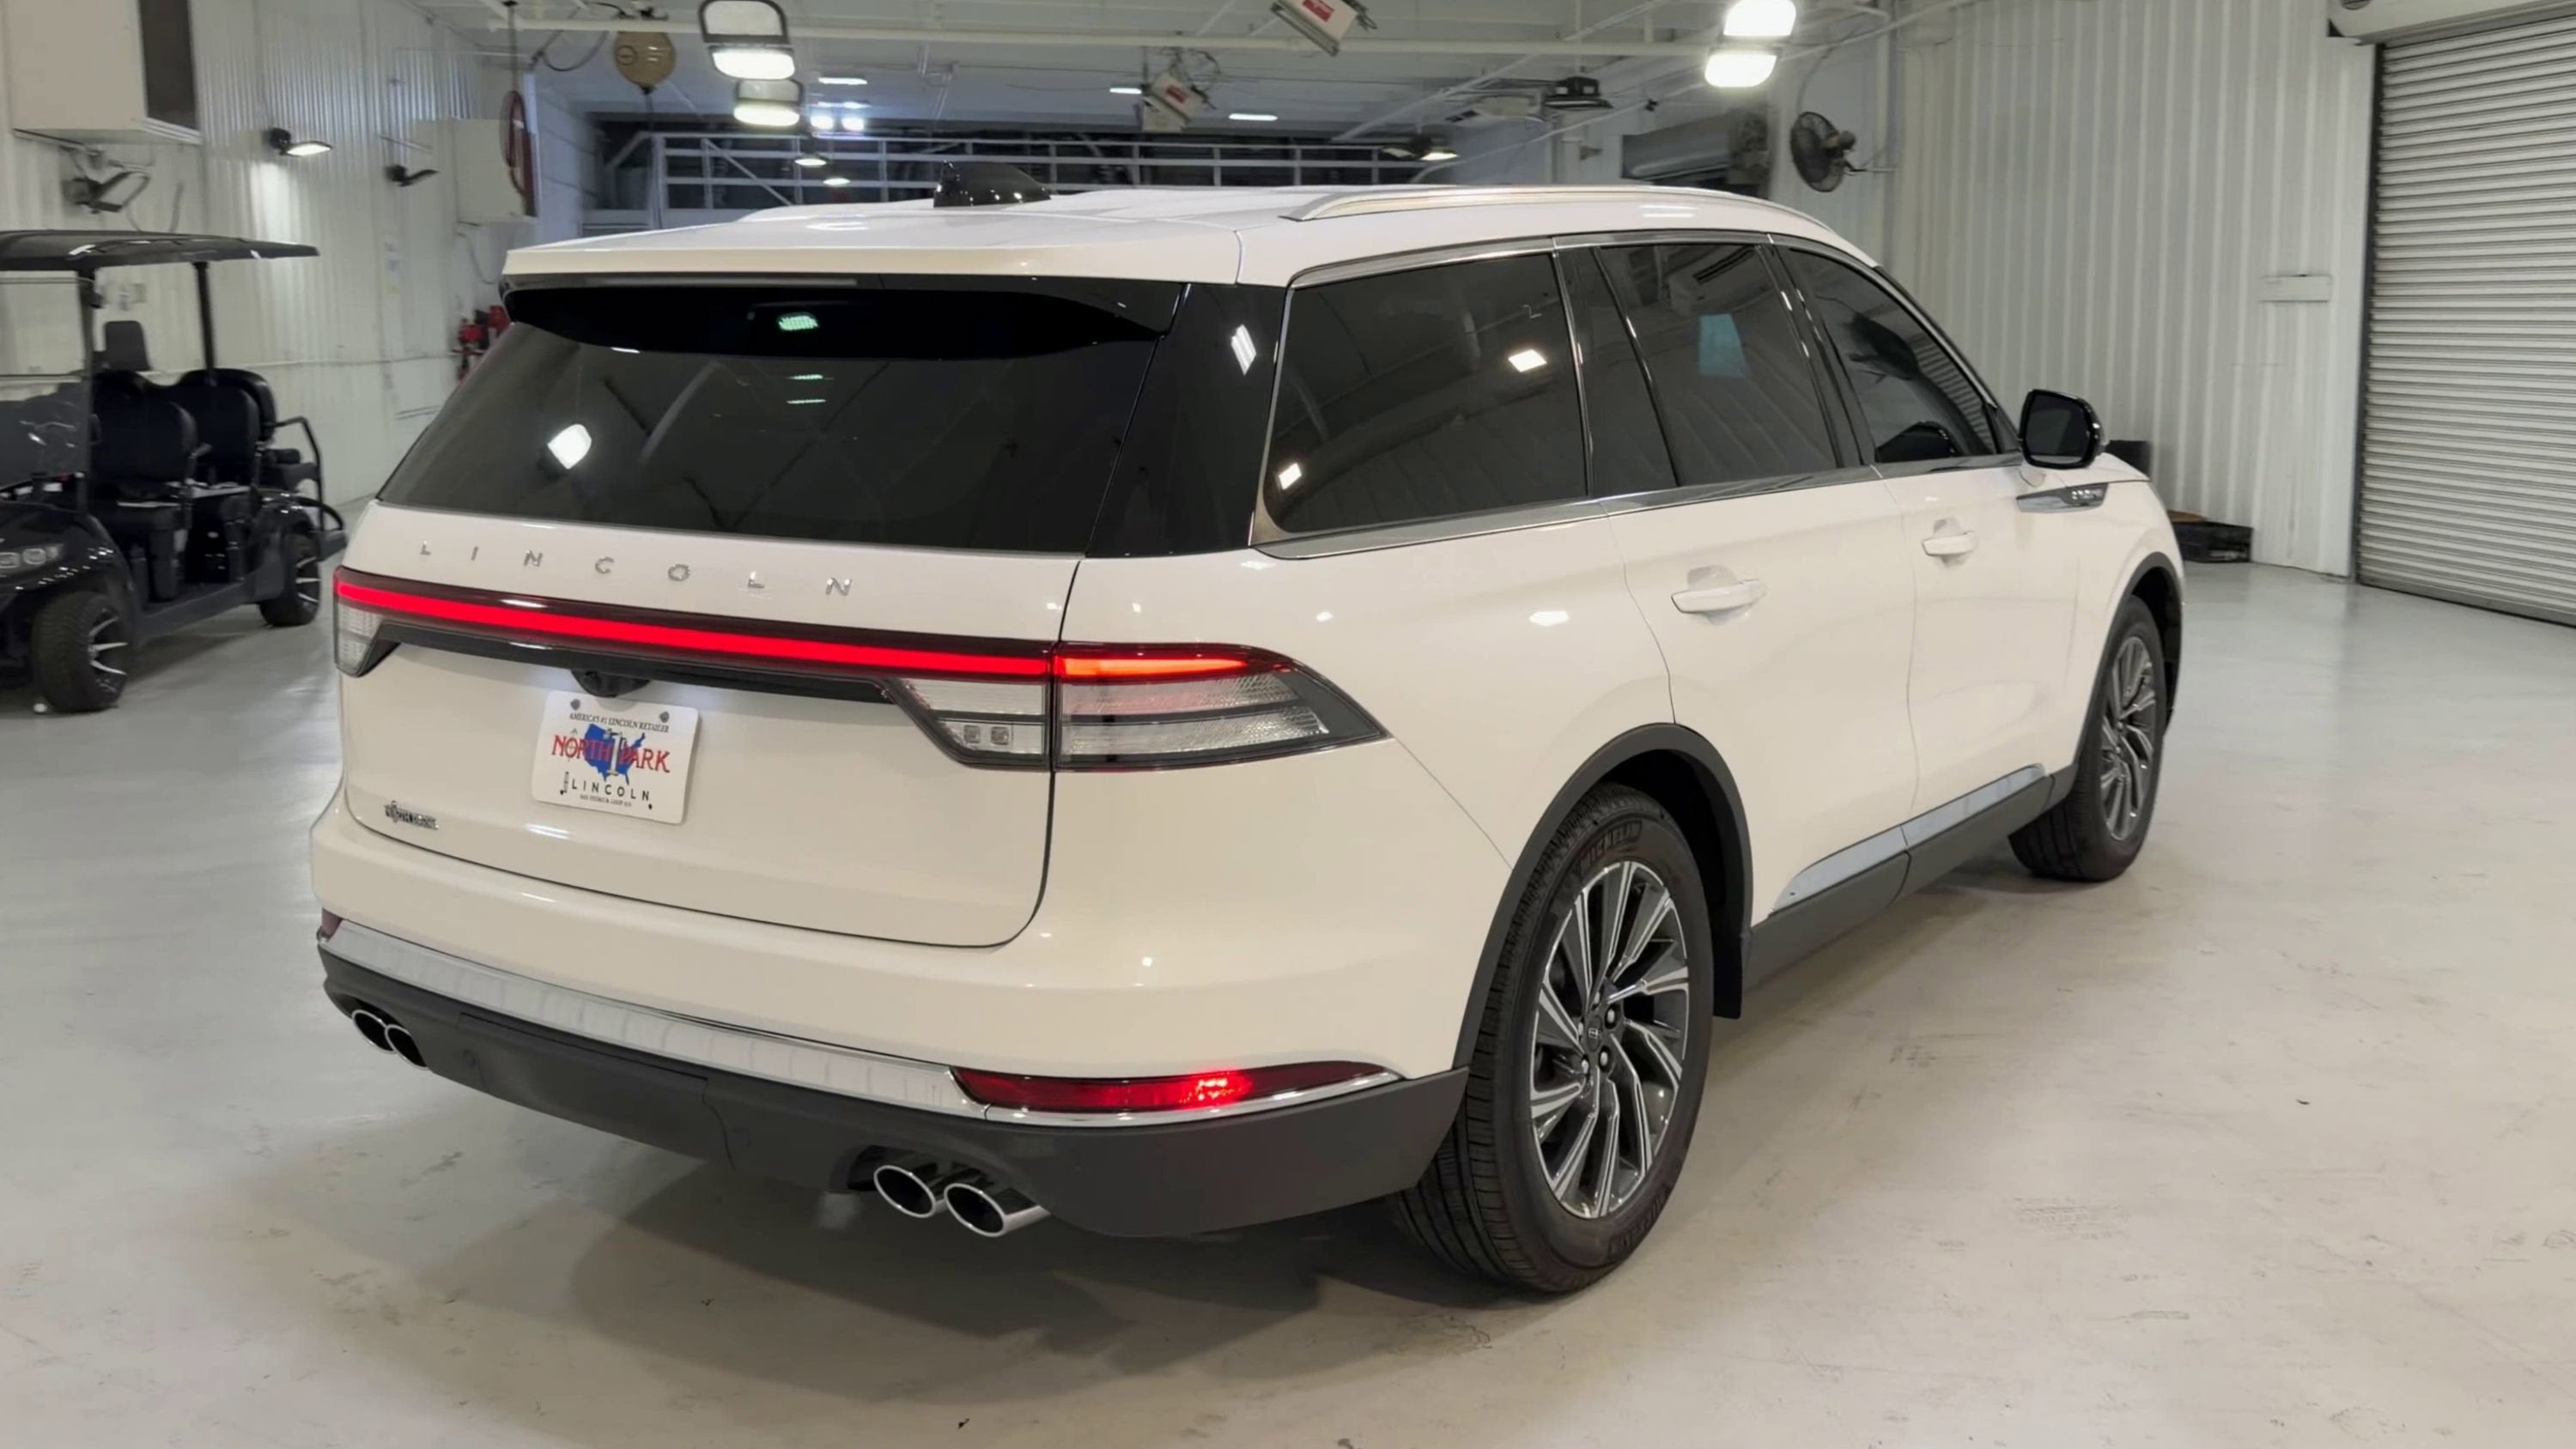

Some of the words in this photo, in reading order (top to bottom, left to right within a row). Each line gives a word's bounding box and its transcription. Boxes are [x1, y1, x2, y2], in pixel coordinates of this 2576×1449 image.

[419, 540, 853, 597] LINCOLN
[608, 717, 639, 729] LINCOLN
[551, 734, 613, 763] NORTH
[617, 741, 671, 773] PARK
[571, 778, 650, 802] LINCOLN
